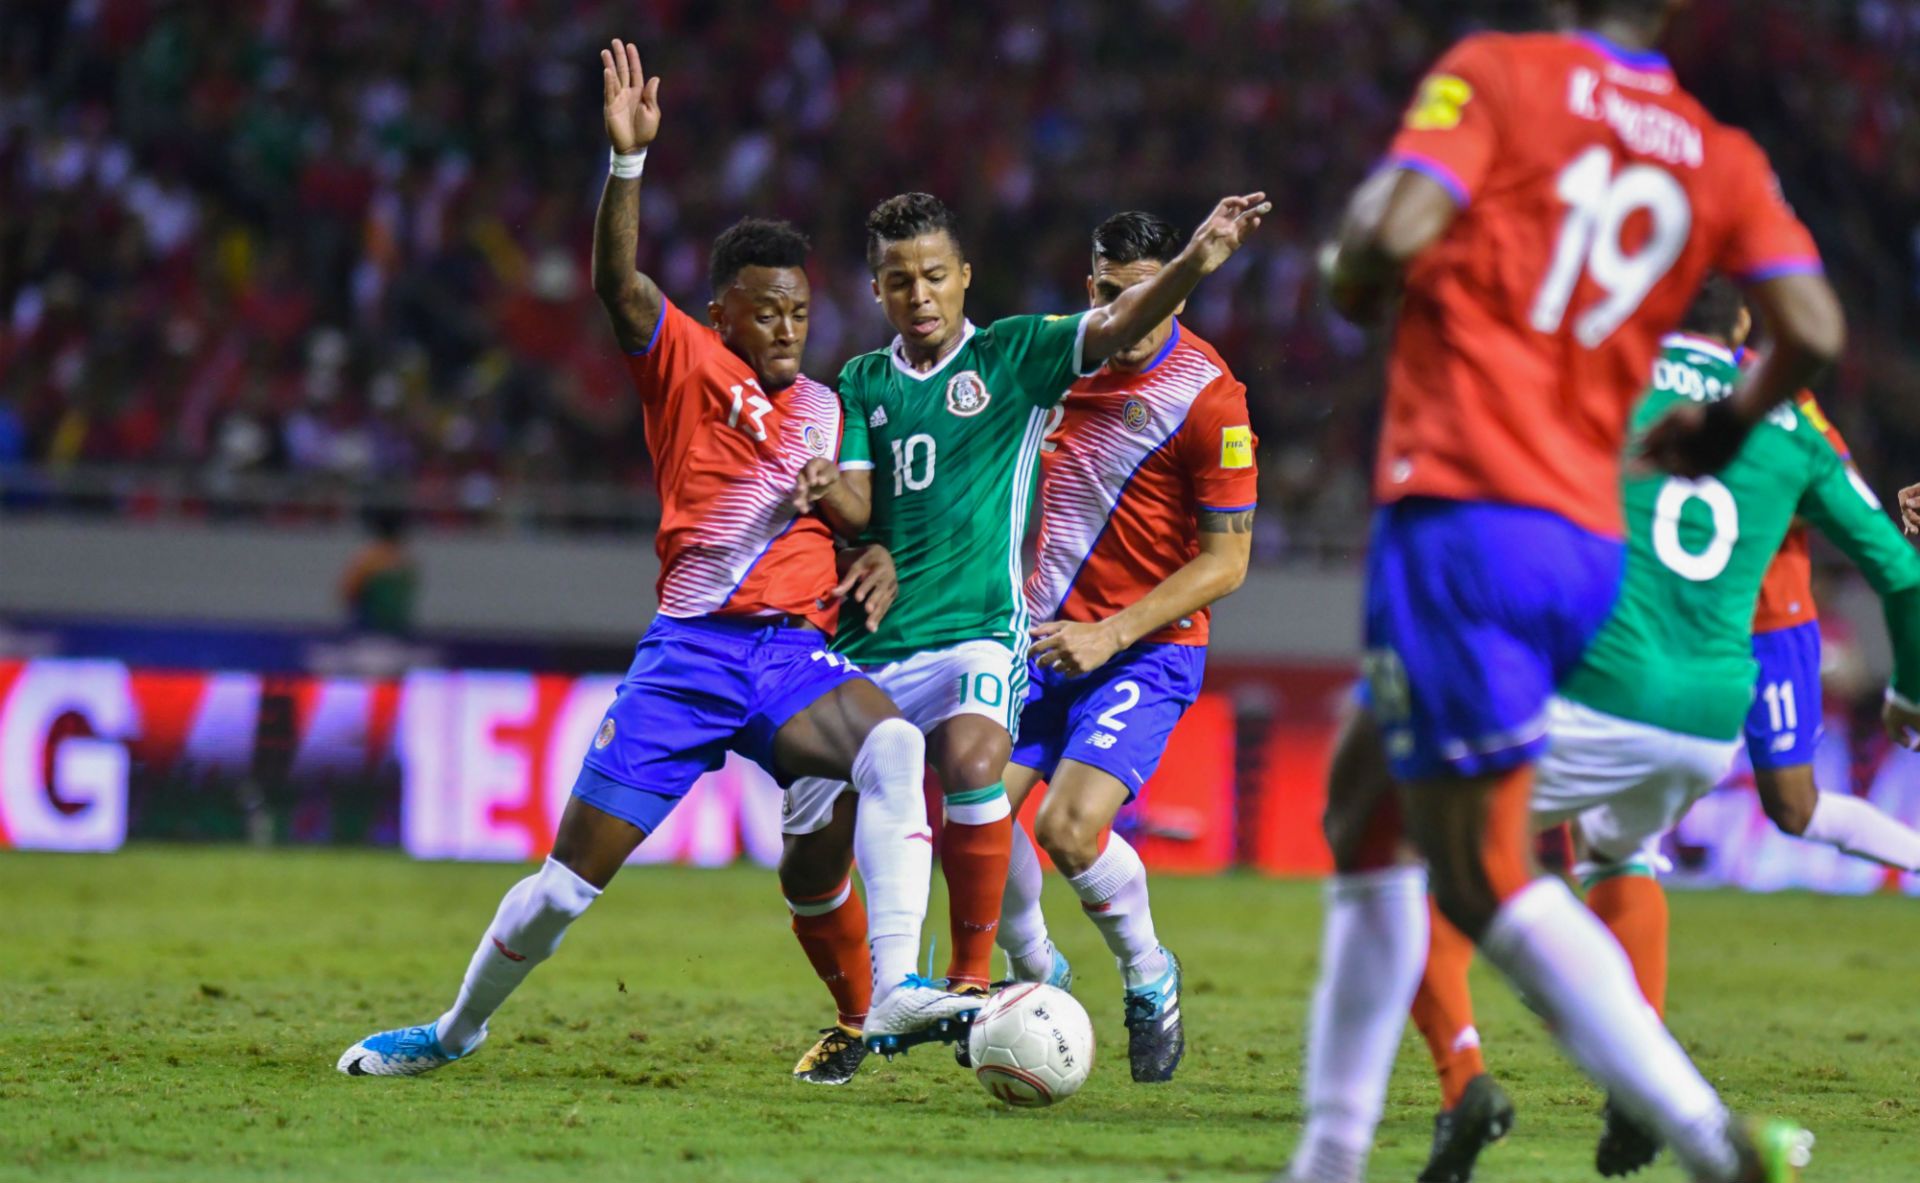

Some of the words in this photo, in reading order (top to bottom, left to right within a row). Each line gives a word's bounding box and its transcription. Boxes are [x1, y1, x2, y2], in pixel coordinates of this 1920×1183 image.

[1528, 144, 1692, 349] 19
[728, 377, 774, 442] 13
[891, 433, 937, 497] 10
[1225, 440, 1244, 449] FIFA
[956, 671, 1003, 708] 10
[1096, 680, 1141, 732] 2
[1762, 680, 1798, 732] 11
